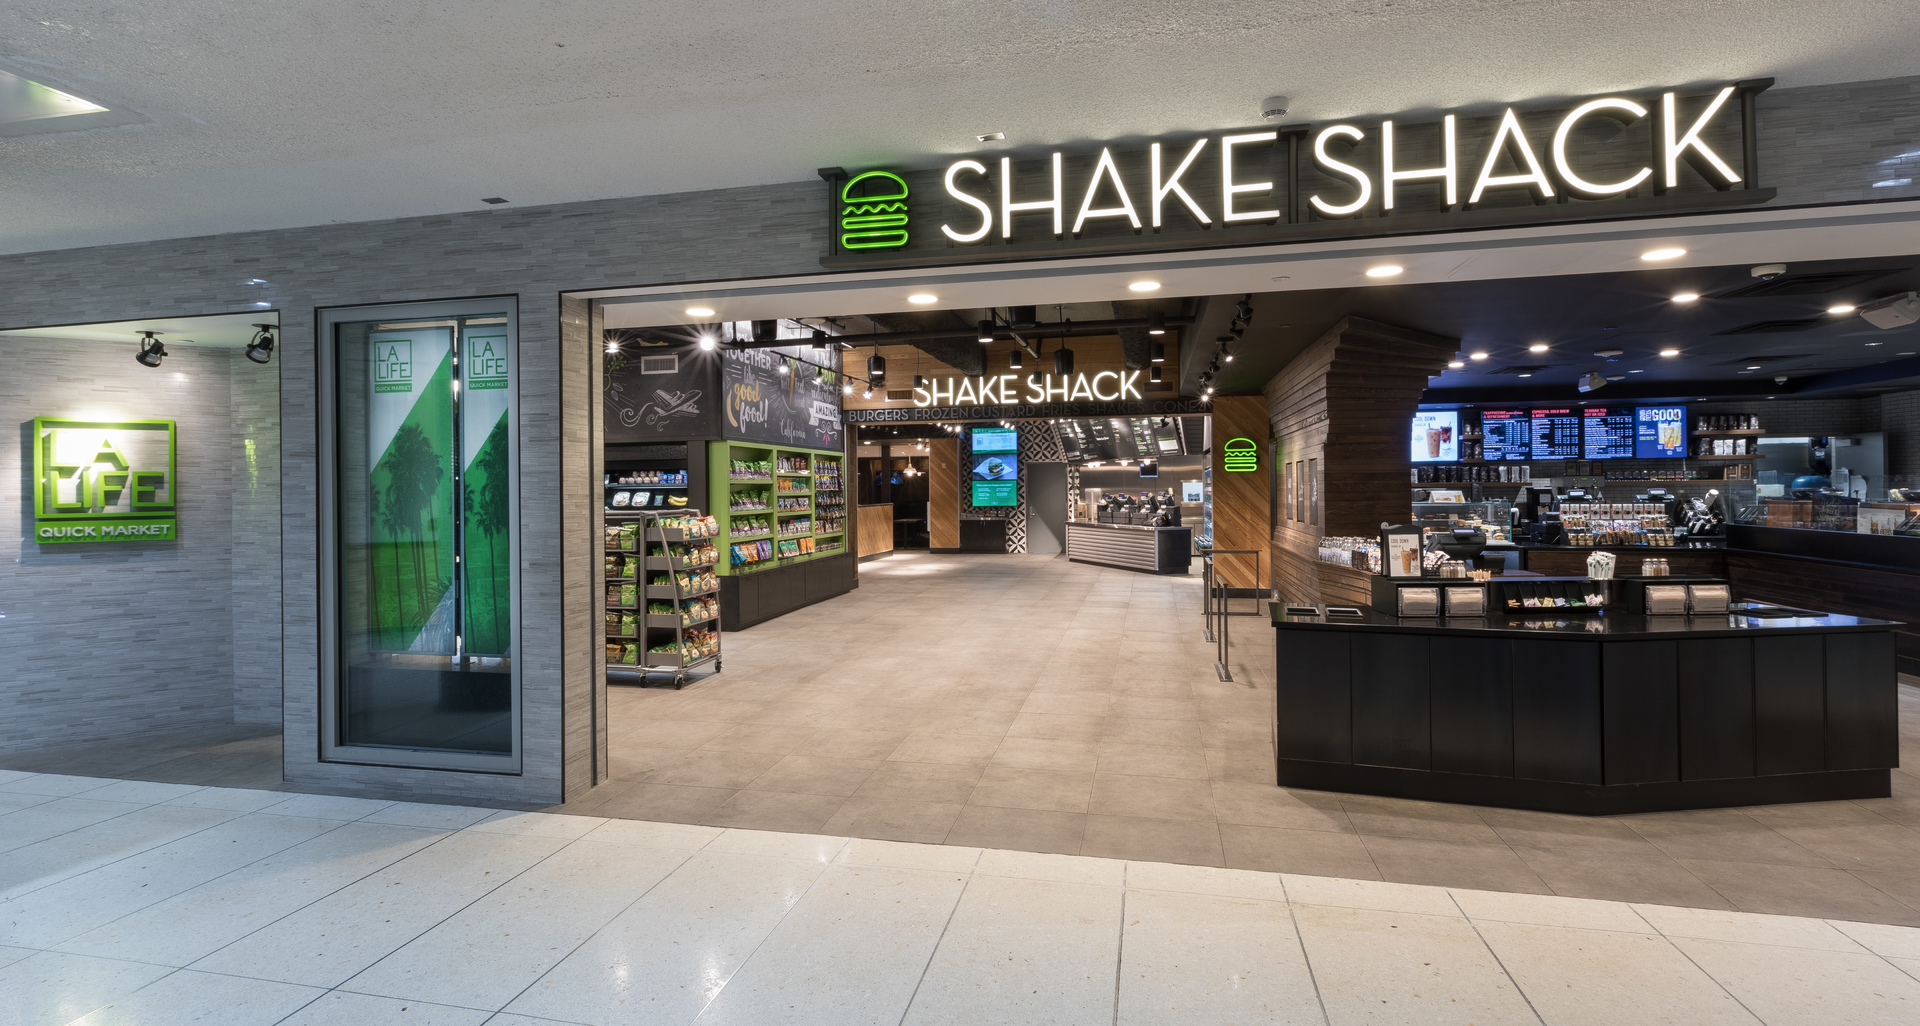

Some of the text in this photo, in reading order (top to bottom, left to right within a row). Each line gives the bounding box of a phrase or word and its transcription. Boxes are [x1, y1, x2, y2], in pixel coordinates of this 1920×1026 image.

[941, 86, 1742, 242] SHAKE SHACK
[378, 345, 399, 362] LA
[472, 341, 495, 358] LA
[726, 348, 771, 371] TOGETHER
[378, 362, 412, 379] LIFE
[472, 358, 507, 375] LIFE
[734, 380, 761, 411] good
[913, 370, 1142, 407] SHAKE SHACK
[739, 398, 769, 433] food!
[849, 408, 909, 422] BURGERS
[914, 406, 969, 420] FROZEN
[971, 404, 1036, 419] CUSTARD
[1042, 403, 1081, 417] FRIES
[1087, 401, 1145, 415] SHAKES
[1652, 408, 1681, 421] GOOD
[50, 430, 130, 467] LA
[50, 471, 165, 508] LIFE
[39, 524, 171, 538] QUICK MARKET
